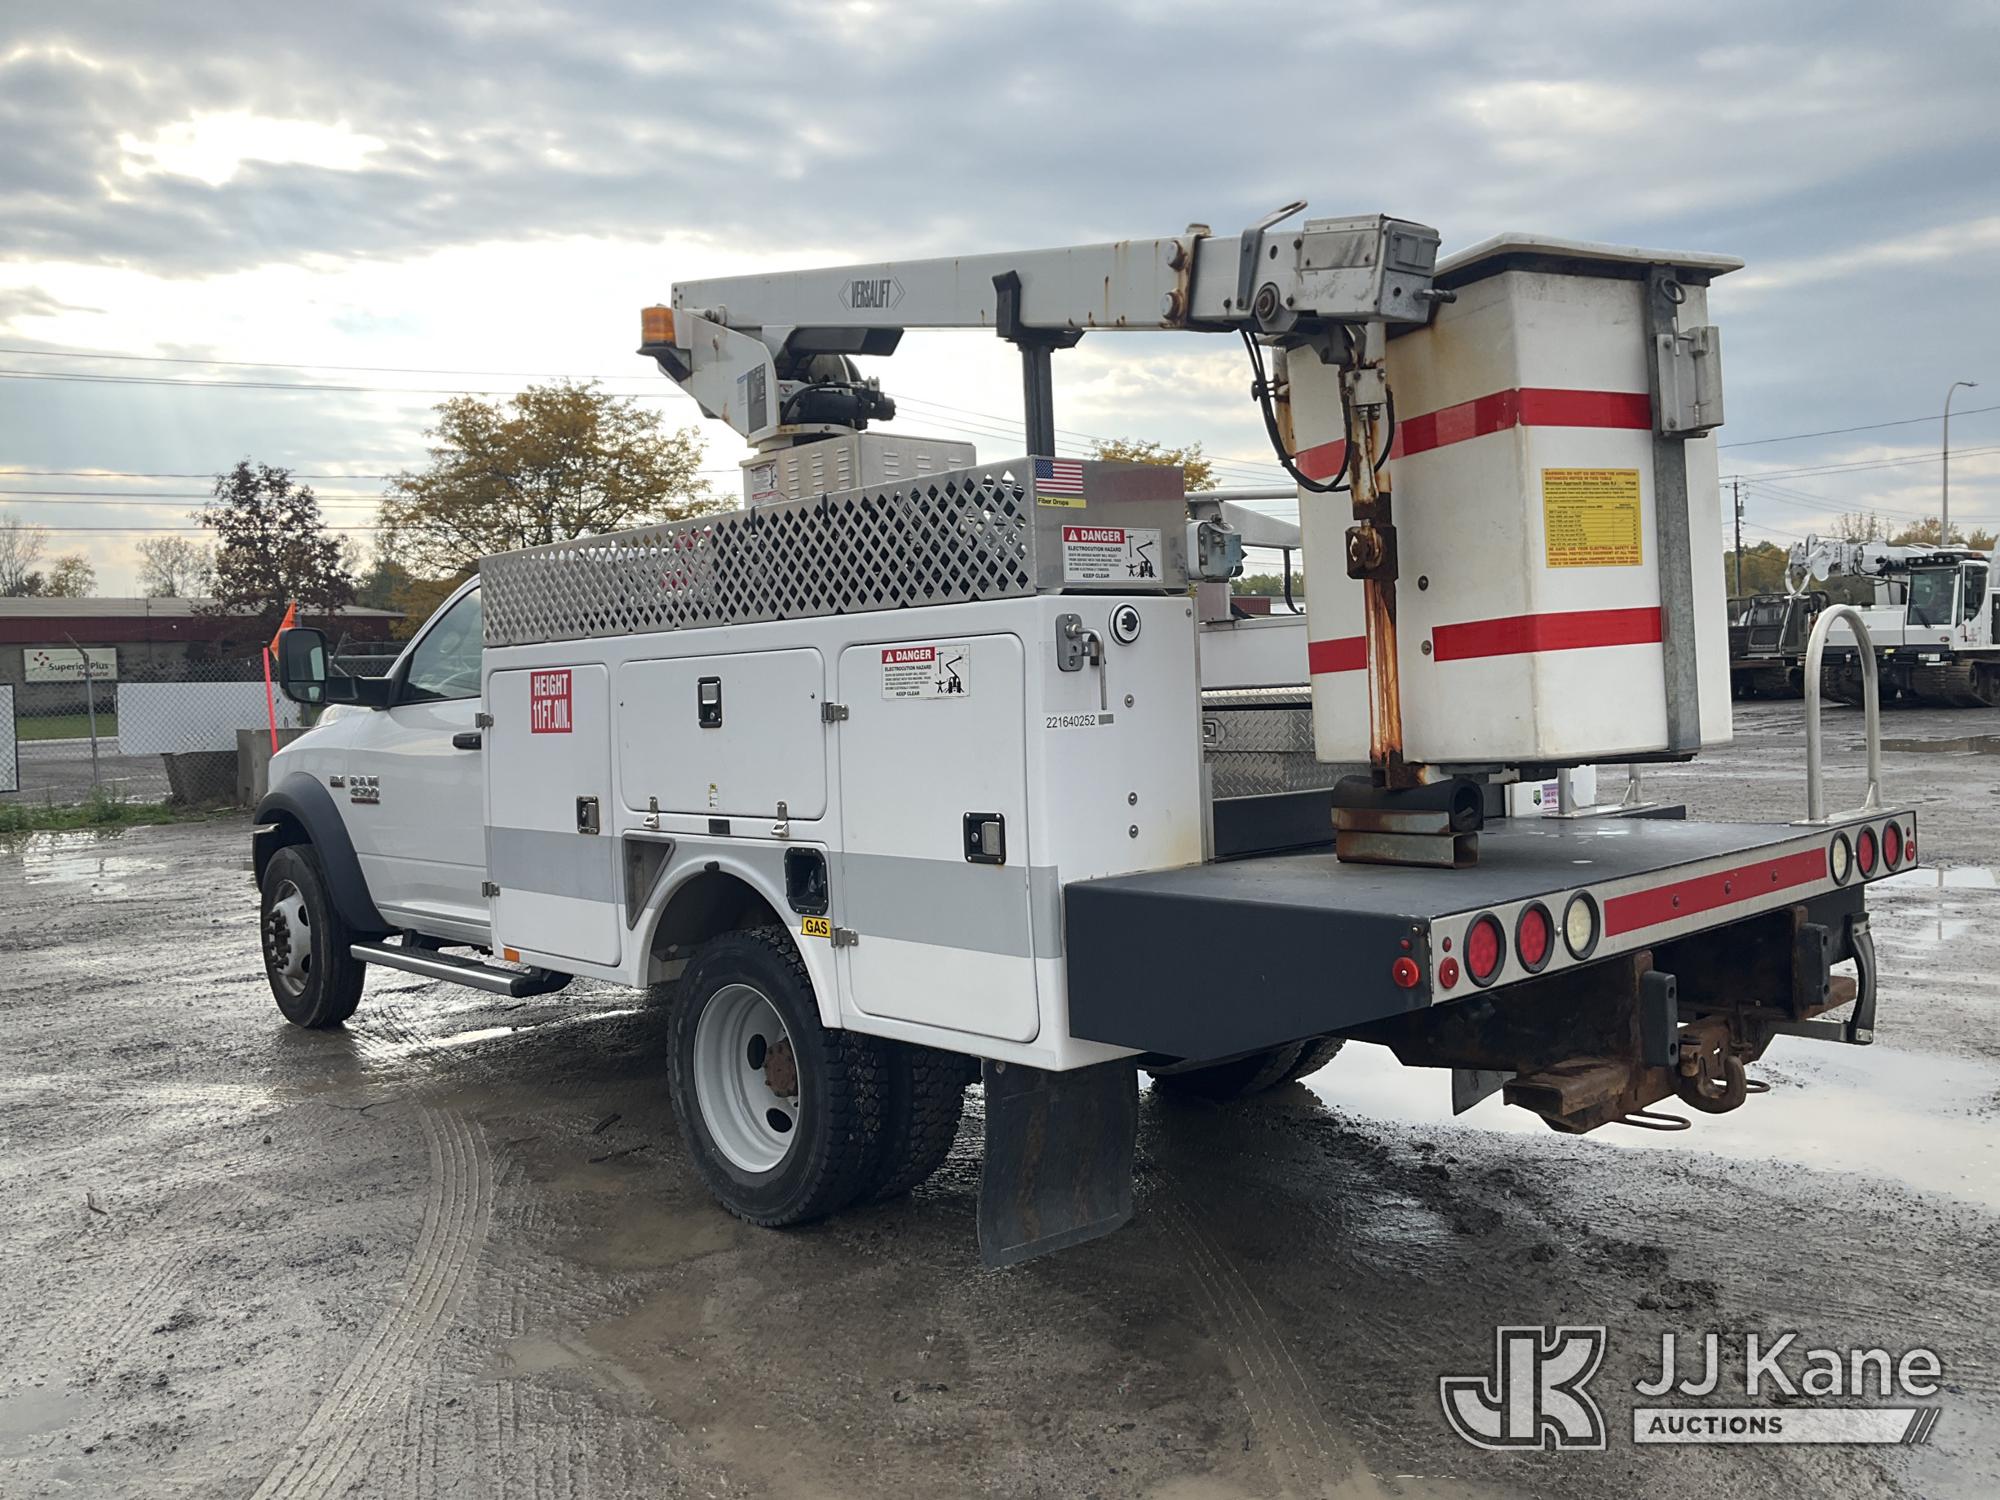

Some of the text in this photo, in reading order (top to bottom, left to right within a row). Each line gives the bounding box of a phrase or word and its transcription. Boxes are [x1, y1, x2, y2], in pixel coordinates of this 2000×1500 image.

[851, 279, 891, 308] VERSALIFT
[1052, 498, 1069, 506] Drops
[1080, 529, 1121, 542] DANGER
[896, 649, 932, 662] DANGER
[48, 662, 109, 672] Superio Plus
[534, 674, 568, 696] HEIGHT
[1046, 714, 1096, 729] 221640252
[350, 775, 379, 786] RAM
[805, 919, 828, 935] GAS
